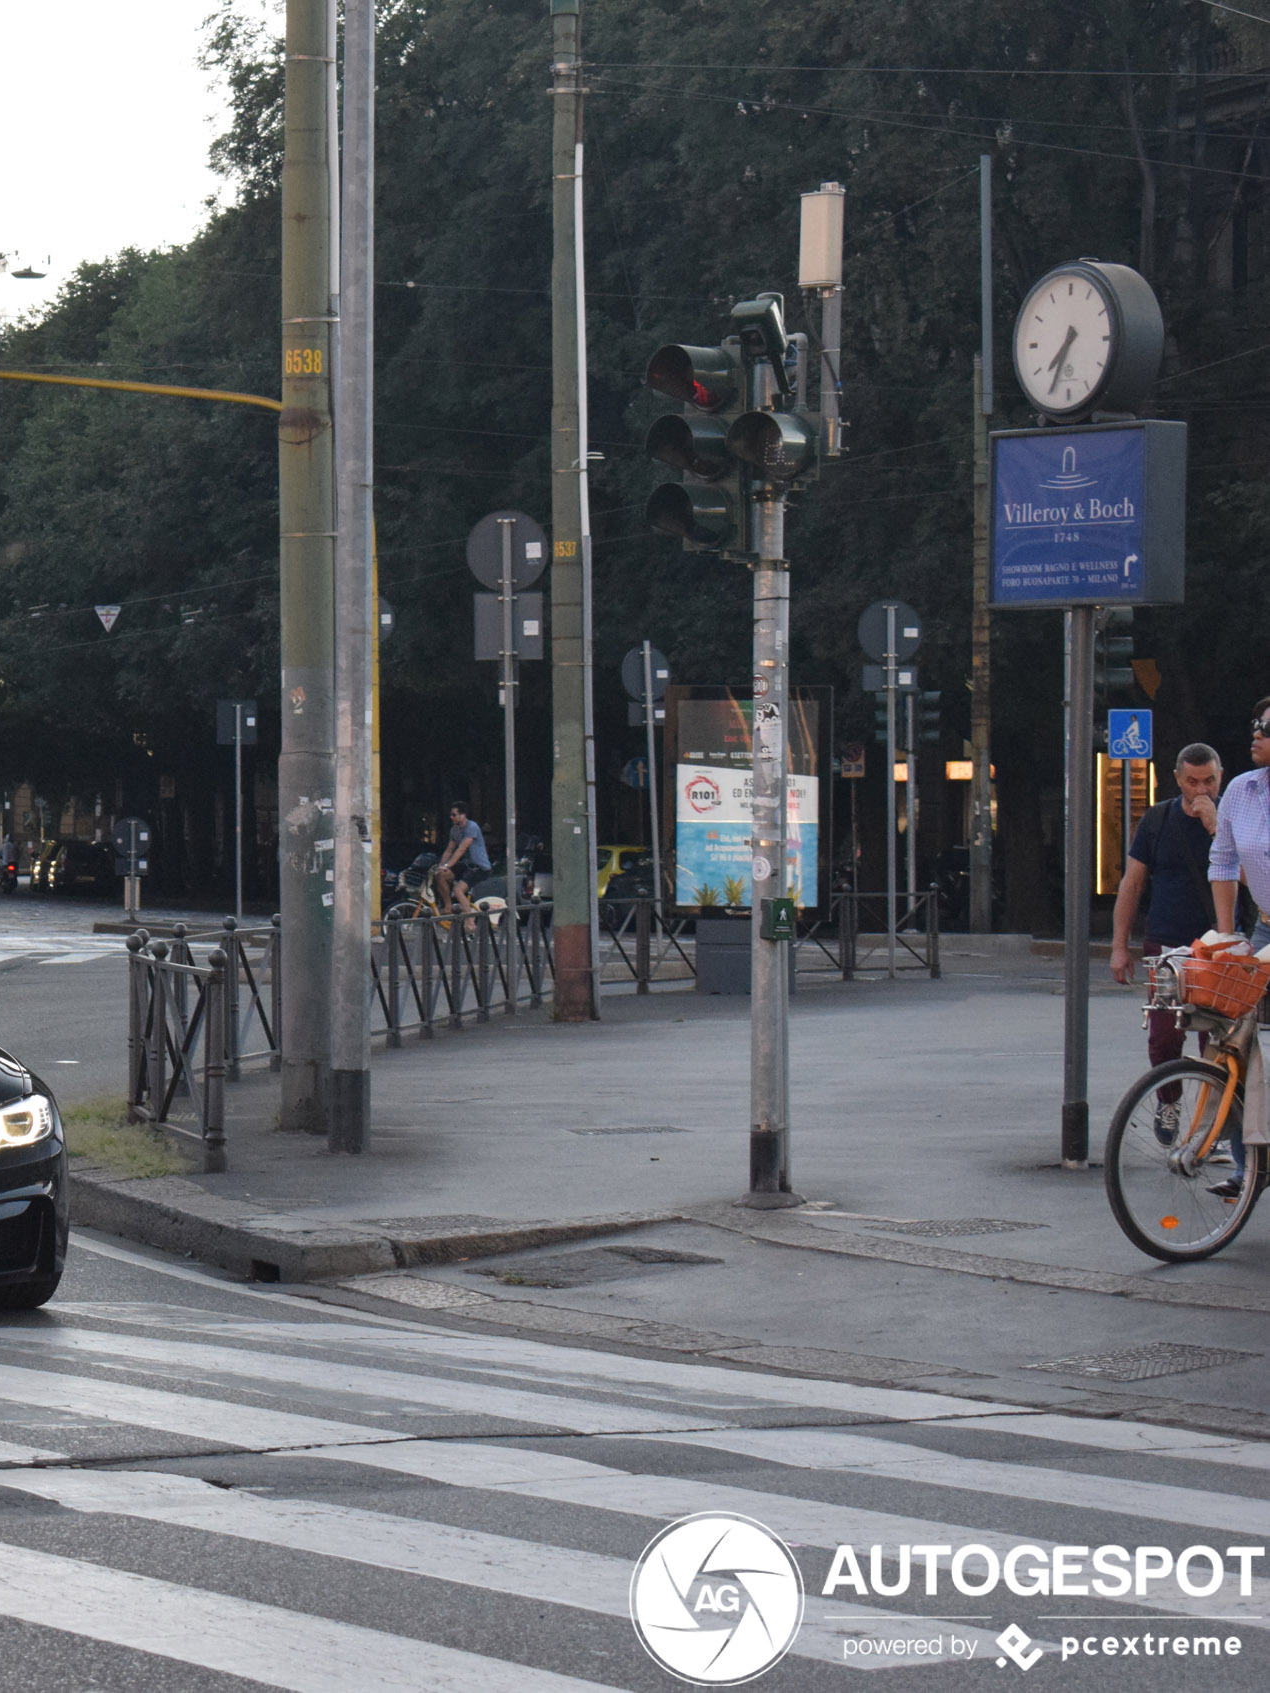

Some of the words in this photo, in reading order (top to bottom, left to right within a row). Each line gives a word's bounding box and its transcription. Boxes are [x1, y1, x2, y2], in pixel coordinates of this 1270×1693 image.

[285, 348, 323, 374] 6538
[1004, 503, 1070, 525] Villeroy
[1073, 503, 1085, 520] &
[1090, 497, 1135, 519] Boch
[1054, 532, 1080, 543] 1748
[1002, 564, 1042, 575] SHOWROOM
[1044, 562, 1070, 573] BAGNO
[1071, 562, 1077, 571] E
[1079, 560, 1118, 571] WELLNESS
[1001, 577, 1021, 587] FORO
[1022, 575, 1070, 587] BUONAPARTE
[1087, 574, 1118, 584] MILANO
[692, 791, 715, 800] R101
